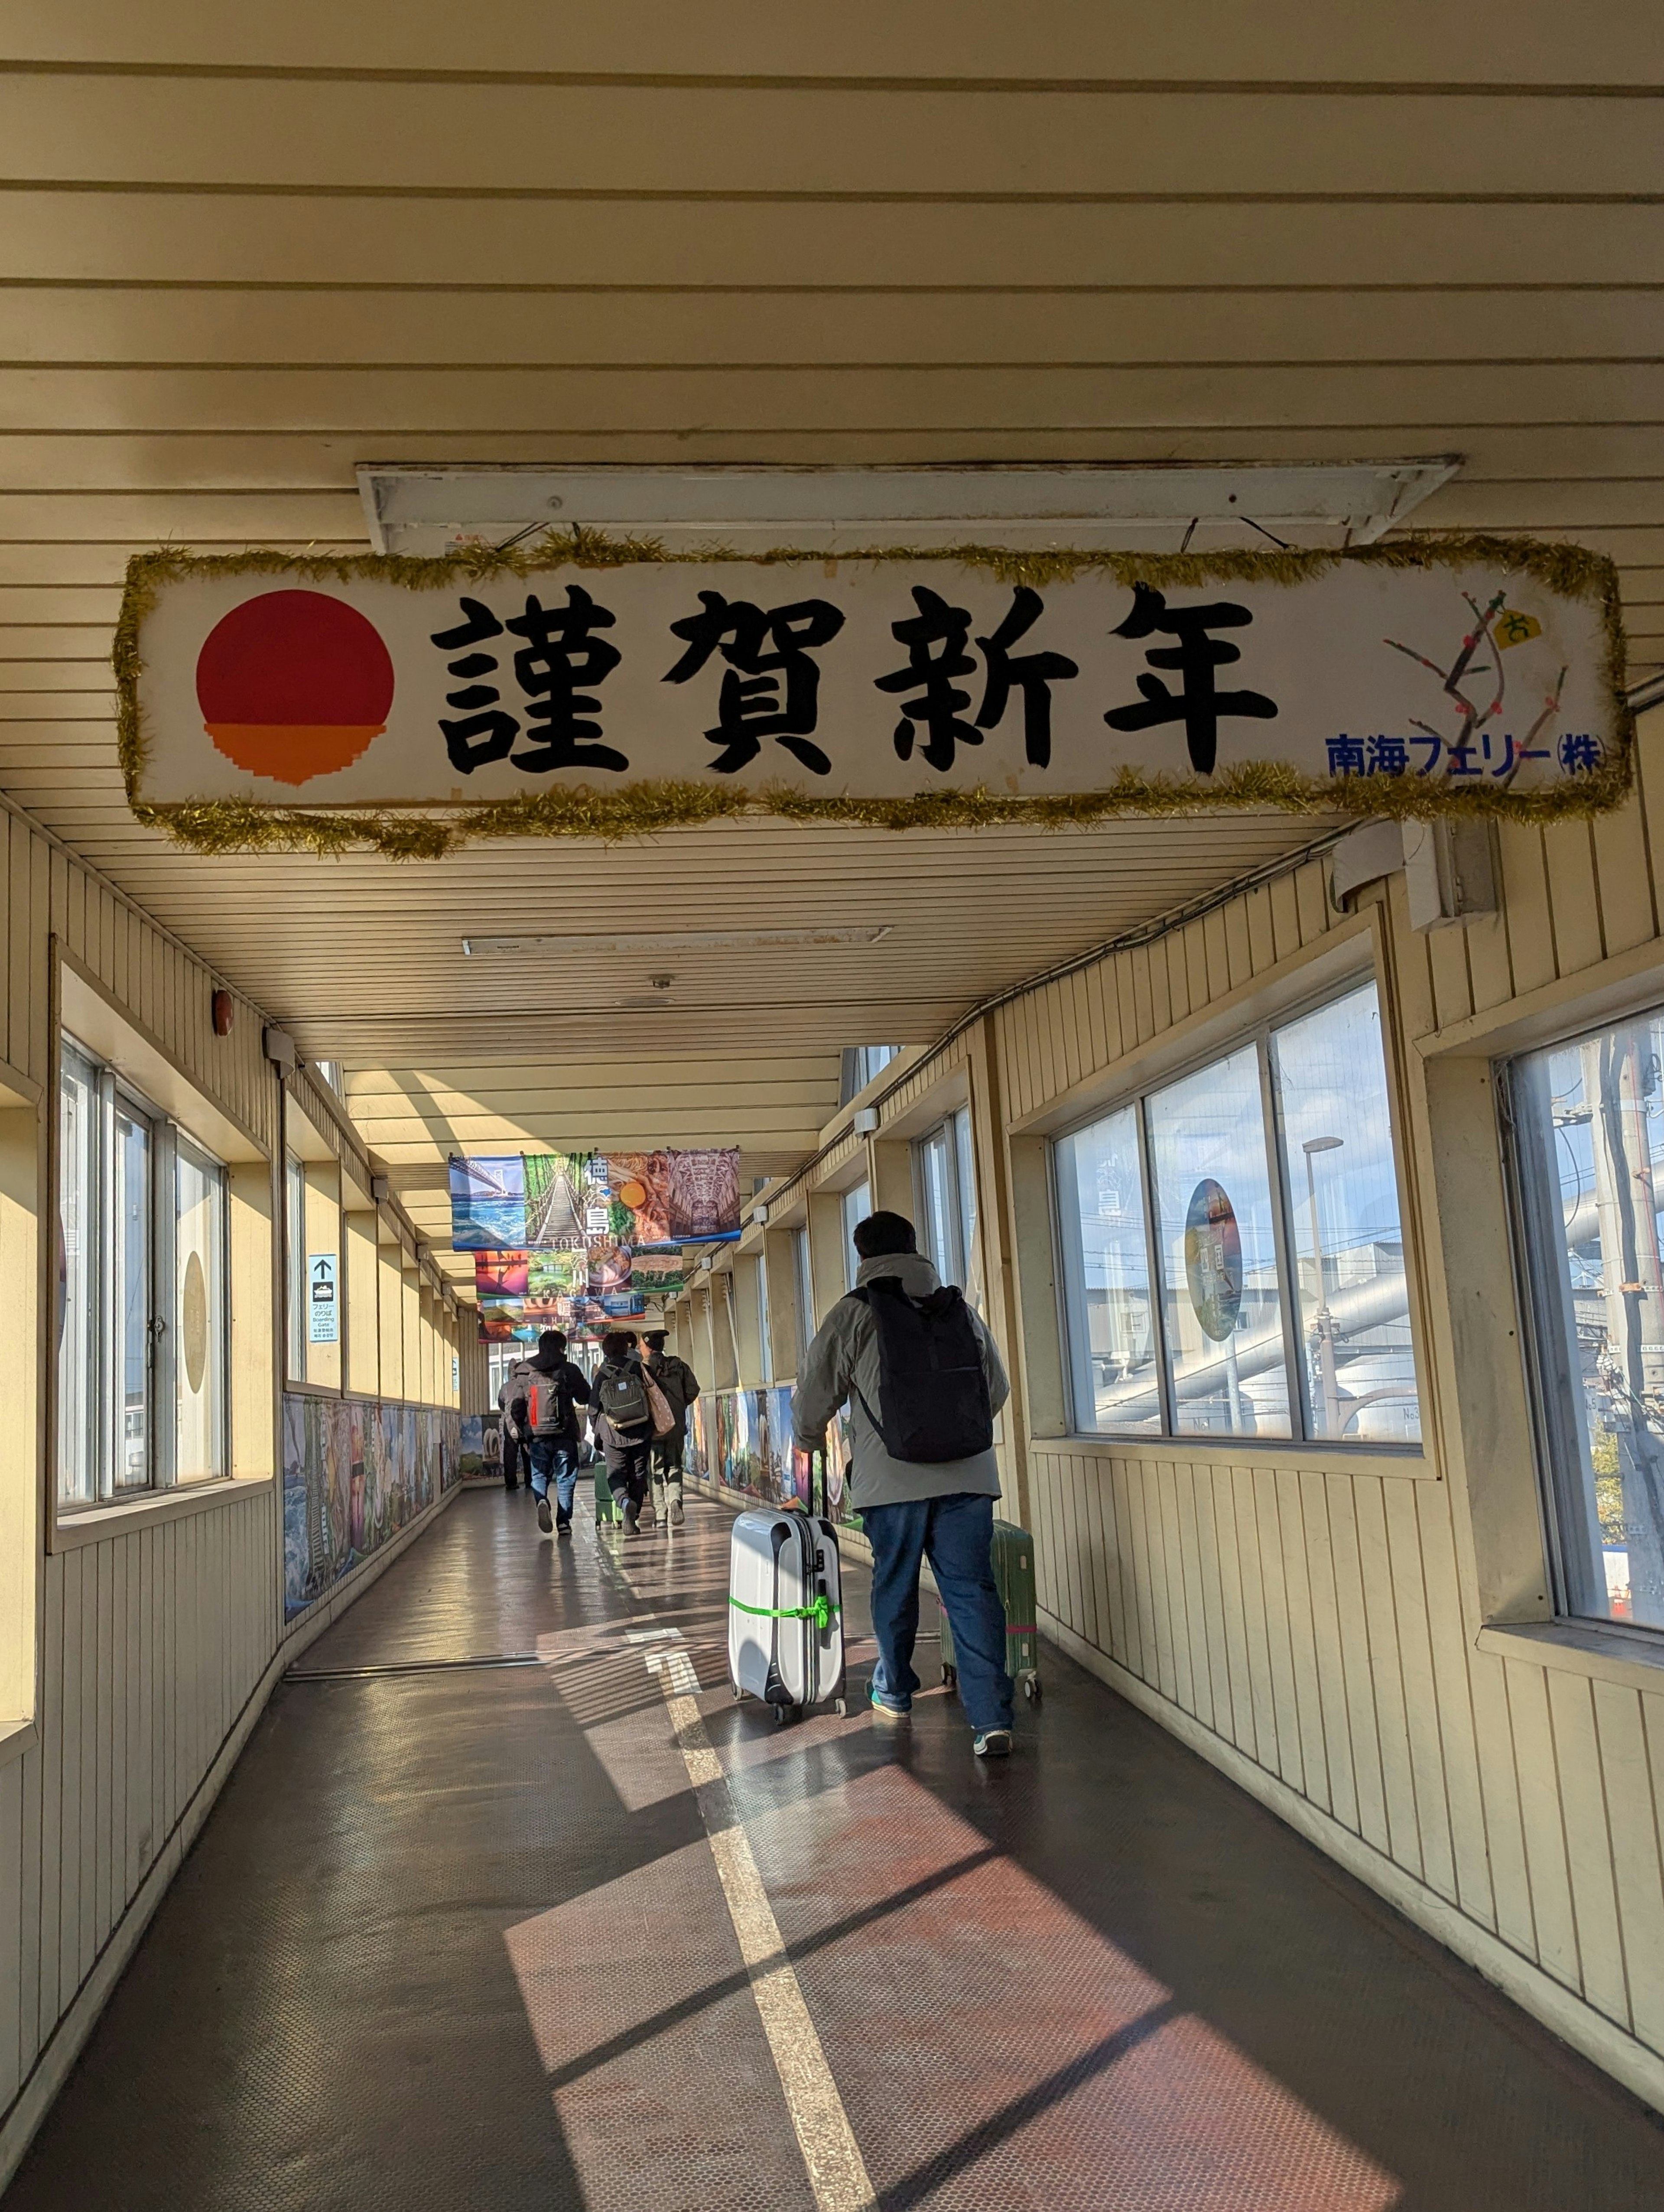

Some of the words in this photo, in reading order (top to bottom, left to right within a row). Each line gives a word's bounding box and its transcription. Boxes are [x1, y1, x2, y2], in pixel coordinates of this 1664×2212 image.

[430, 582, 1278, 775] 謹賀新年
[585, 1157, 609, 1234] 徳島
[551, 1235, 646, 1249] TOKUSHIMA
[543, 1286, 618, 1299] KAGAWA
